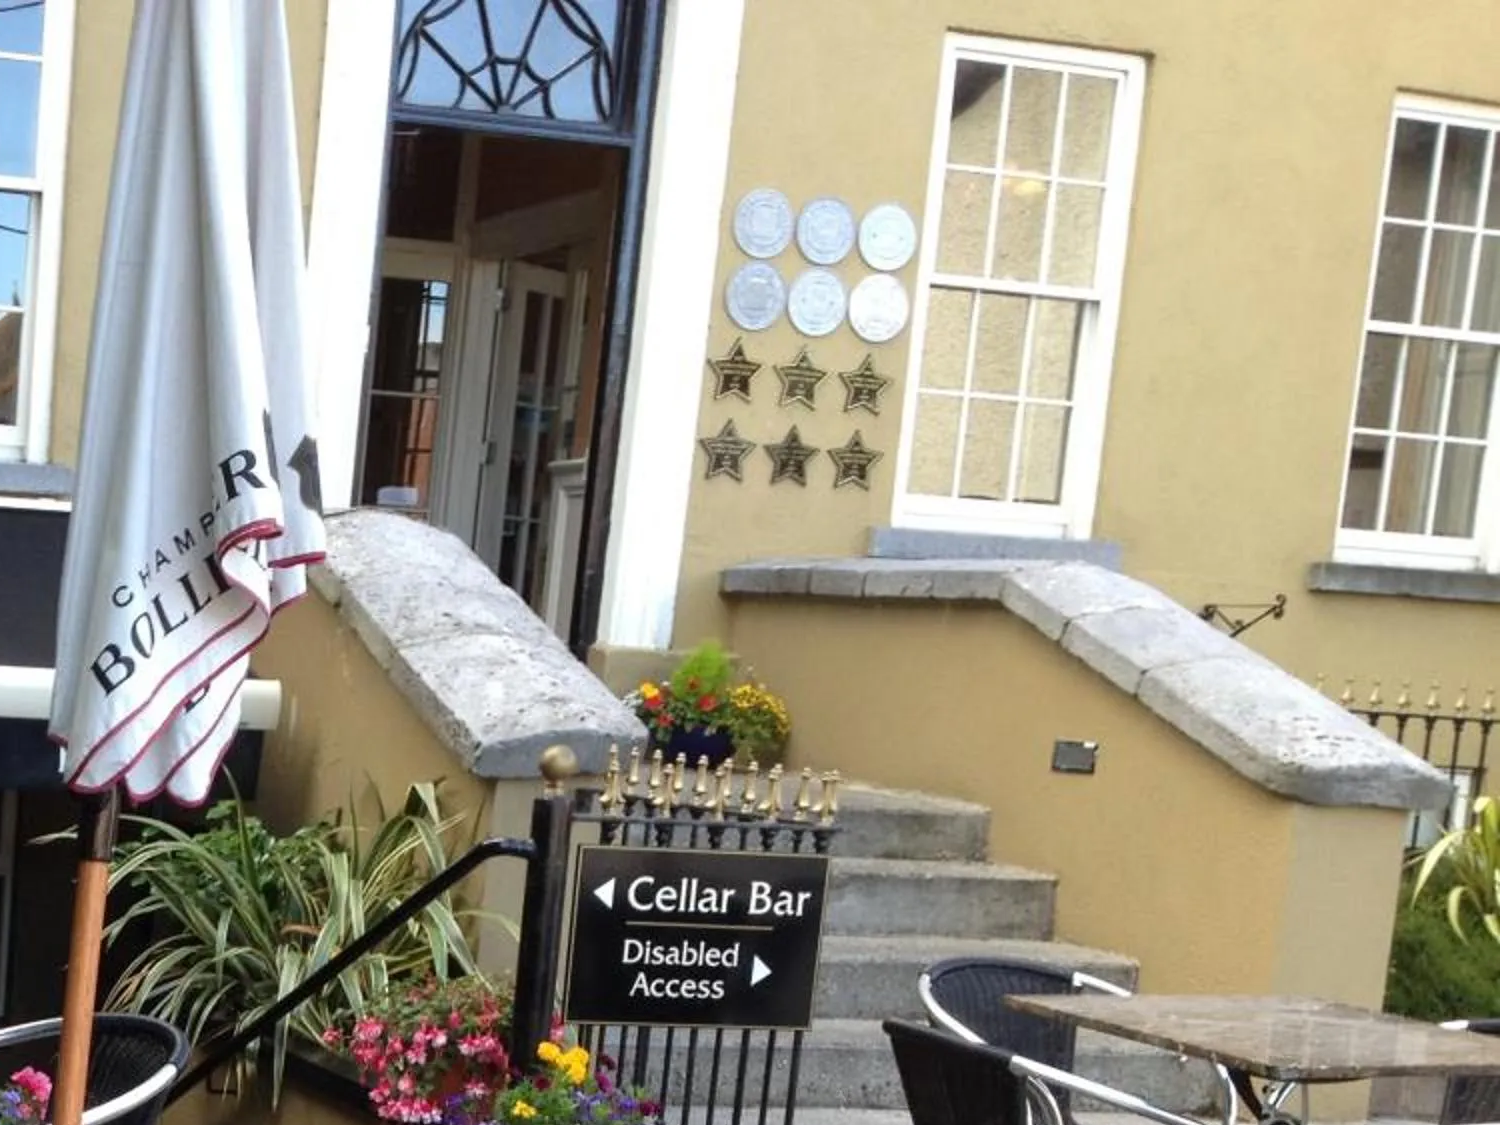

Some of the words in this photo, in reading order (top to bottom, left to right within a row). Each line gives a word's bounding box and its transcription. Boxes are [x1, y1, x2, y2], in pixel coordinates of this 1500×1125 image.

[626, 876, 735, 914] Cellar
[748, 881, 813, 918] Bar
[622, 938, 741, 968] Disabled
[629, 972, 726, 1000] Access
